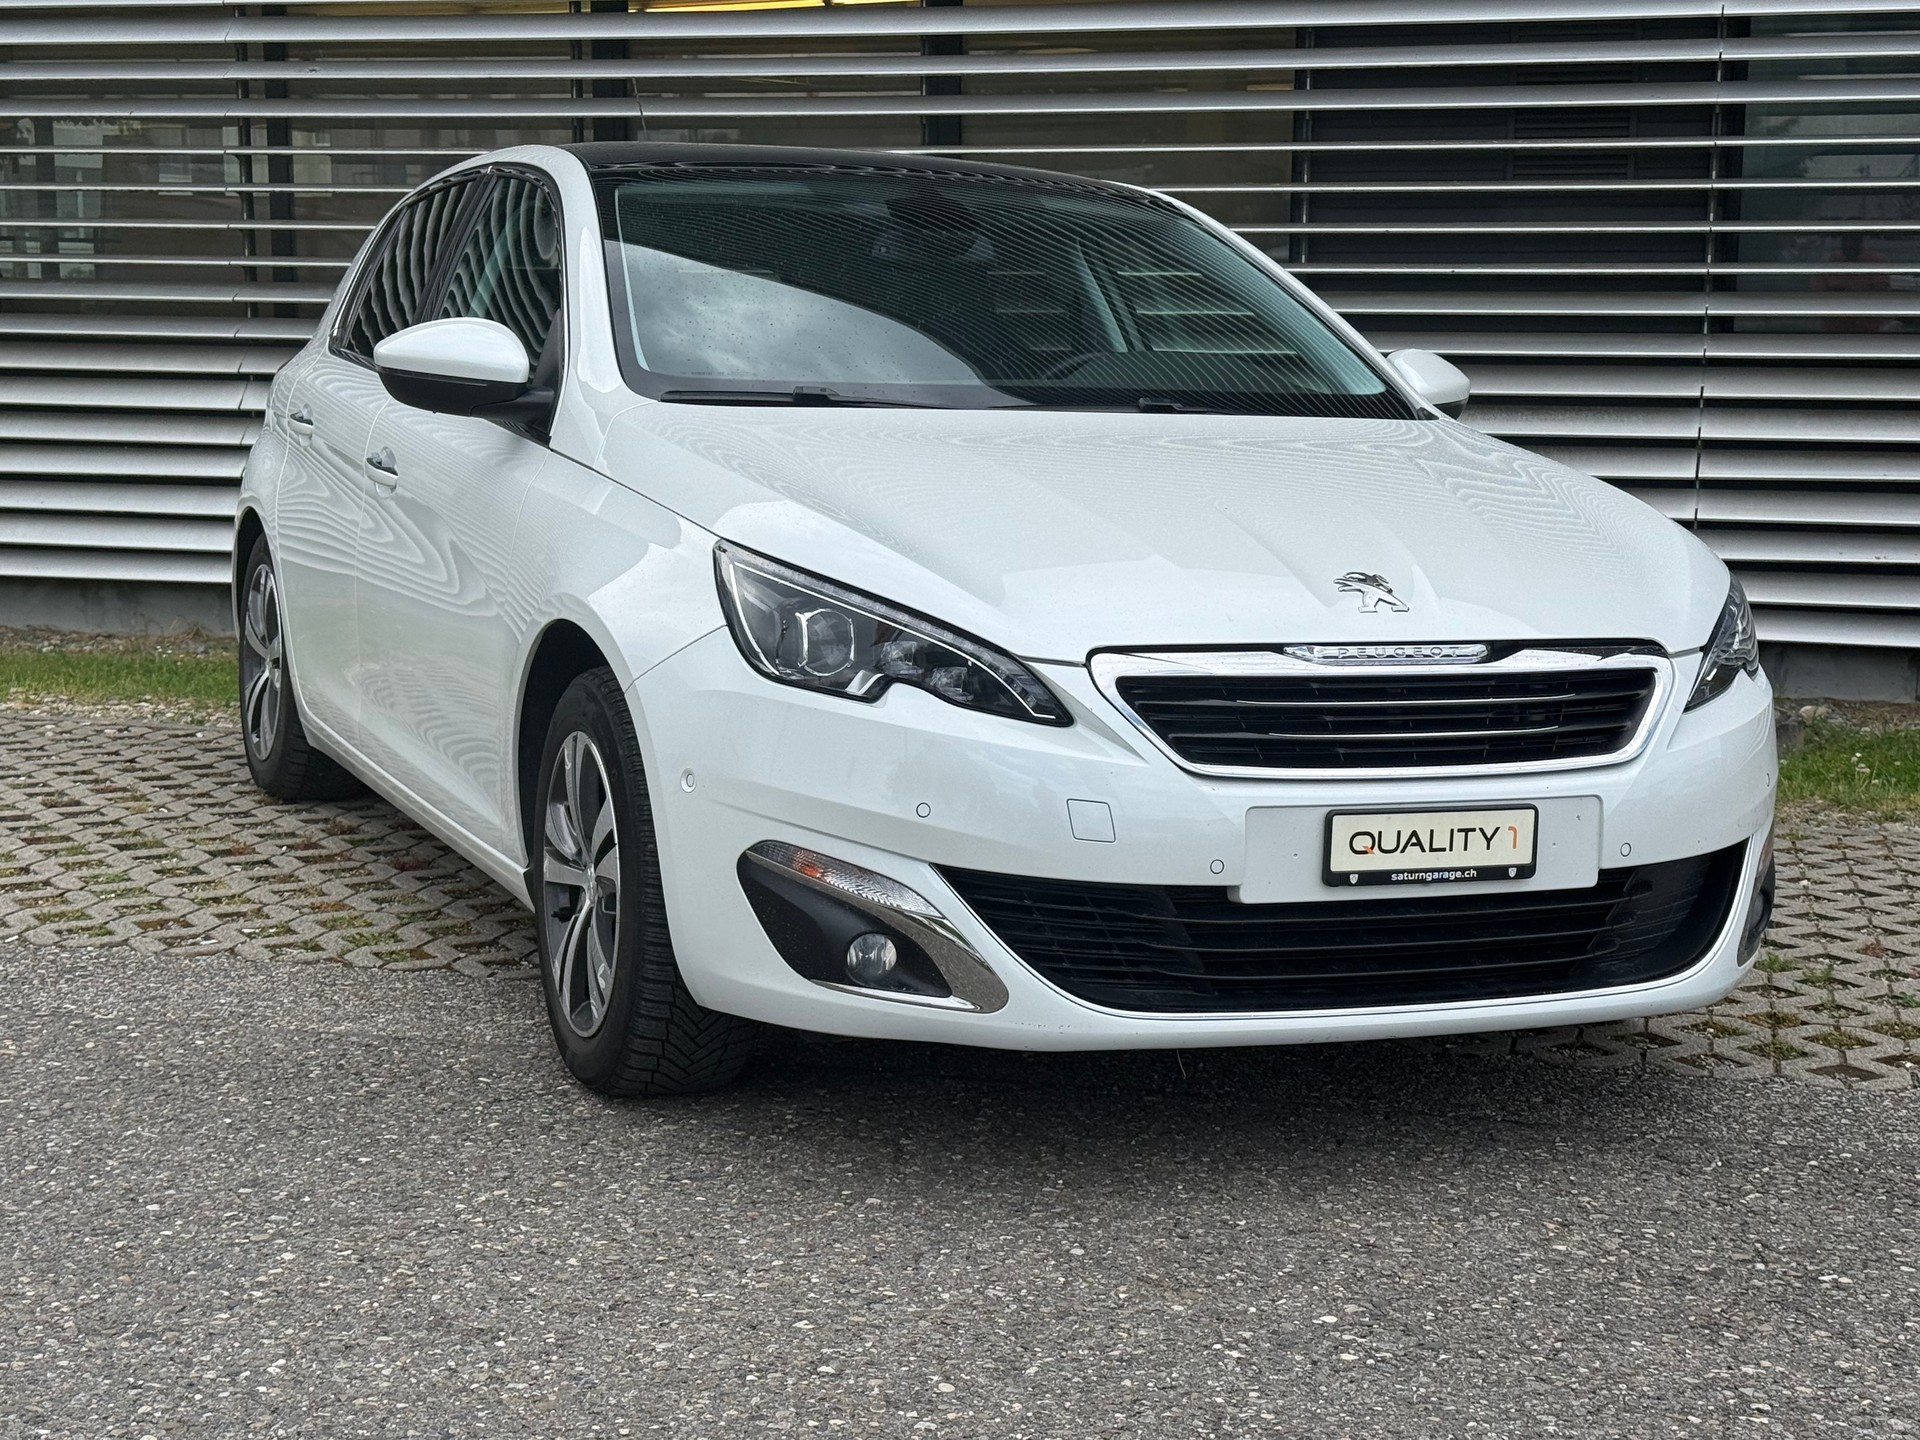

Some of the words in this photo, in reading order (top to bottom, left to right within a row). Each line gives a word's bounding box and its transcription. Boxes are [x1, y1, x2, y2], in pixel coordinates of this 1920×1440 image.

[1338, 646, 1460, 658] PEUGEOT
[1349, 827, 1501, 855] QUALITY
[1508, 826, 1518, 849] 1
[1391, 869, 1477, 882] saturngarage.ch
